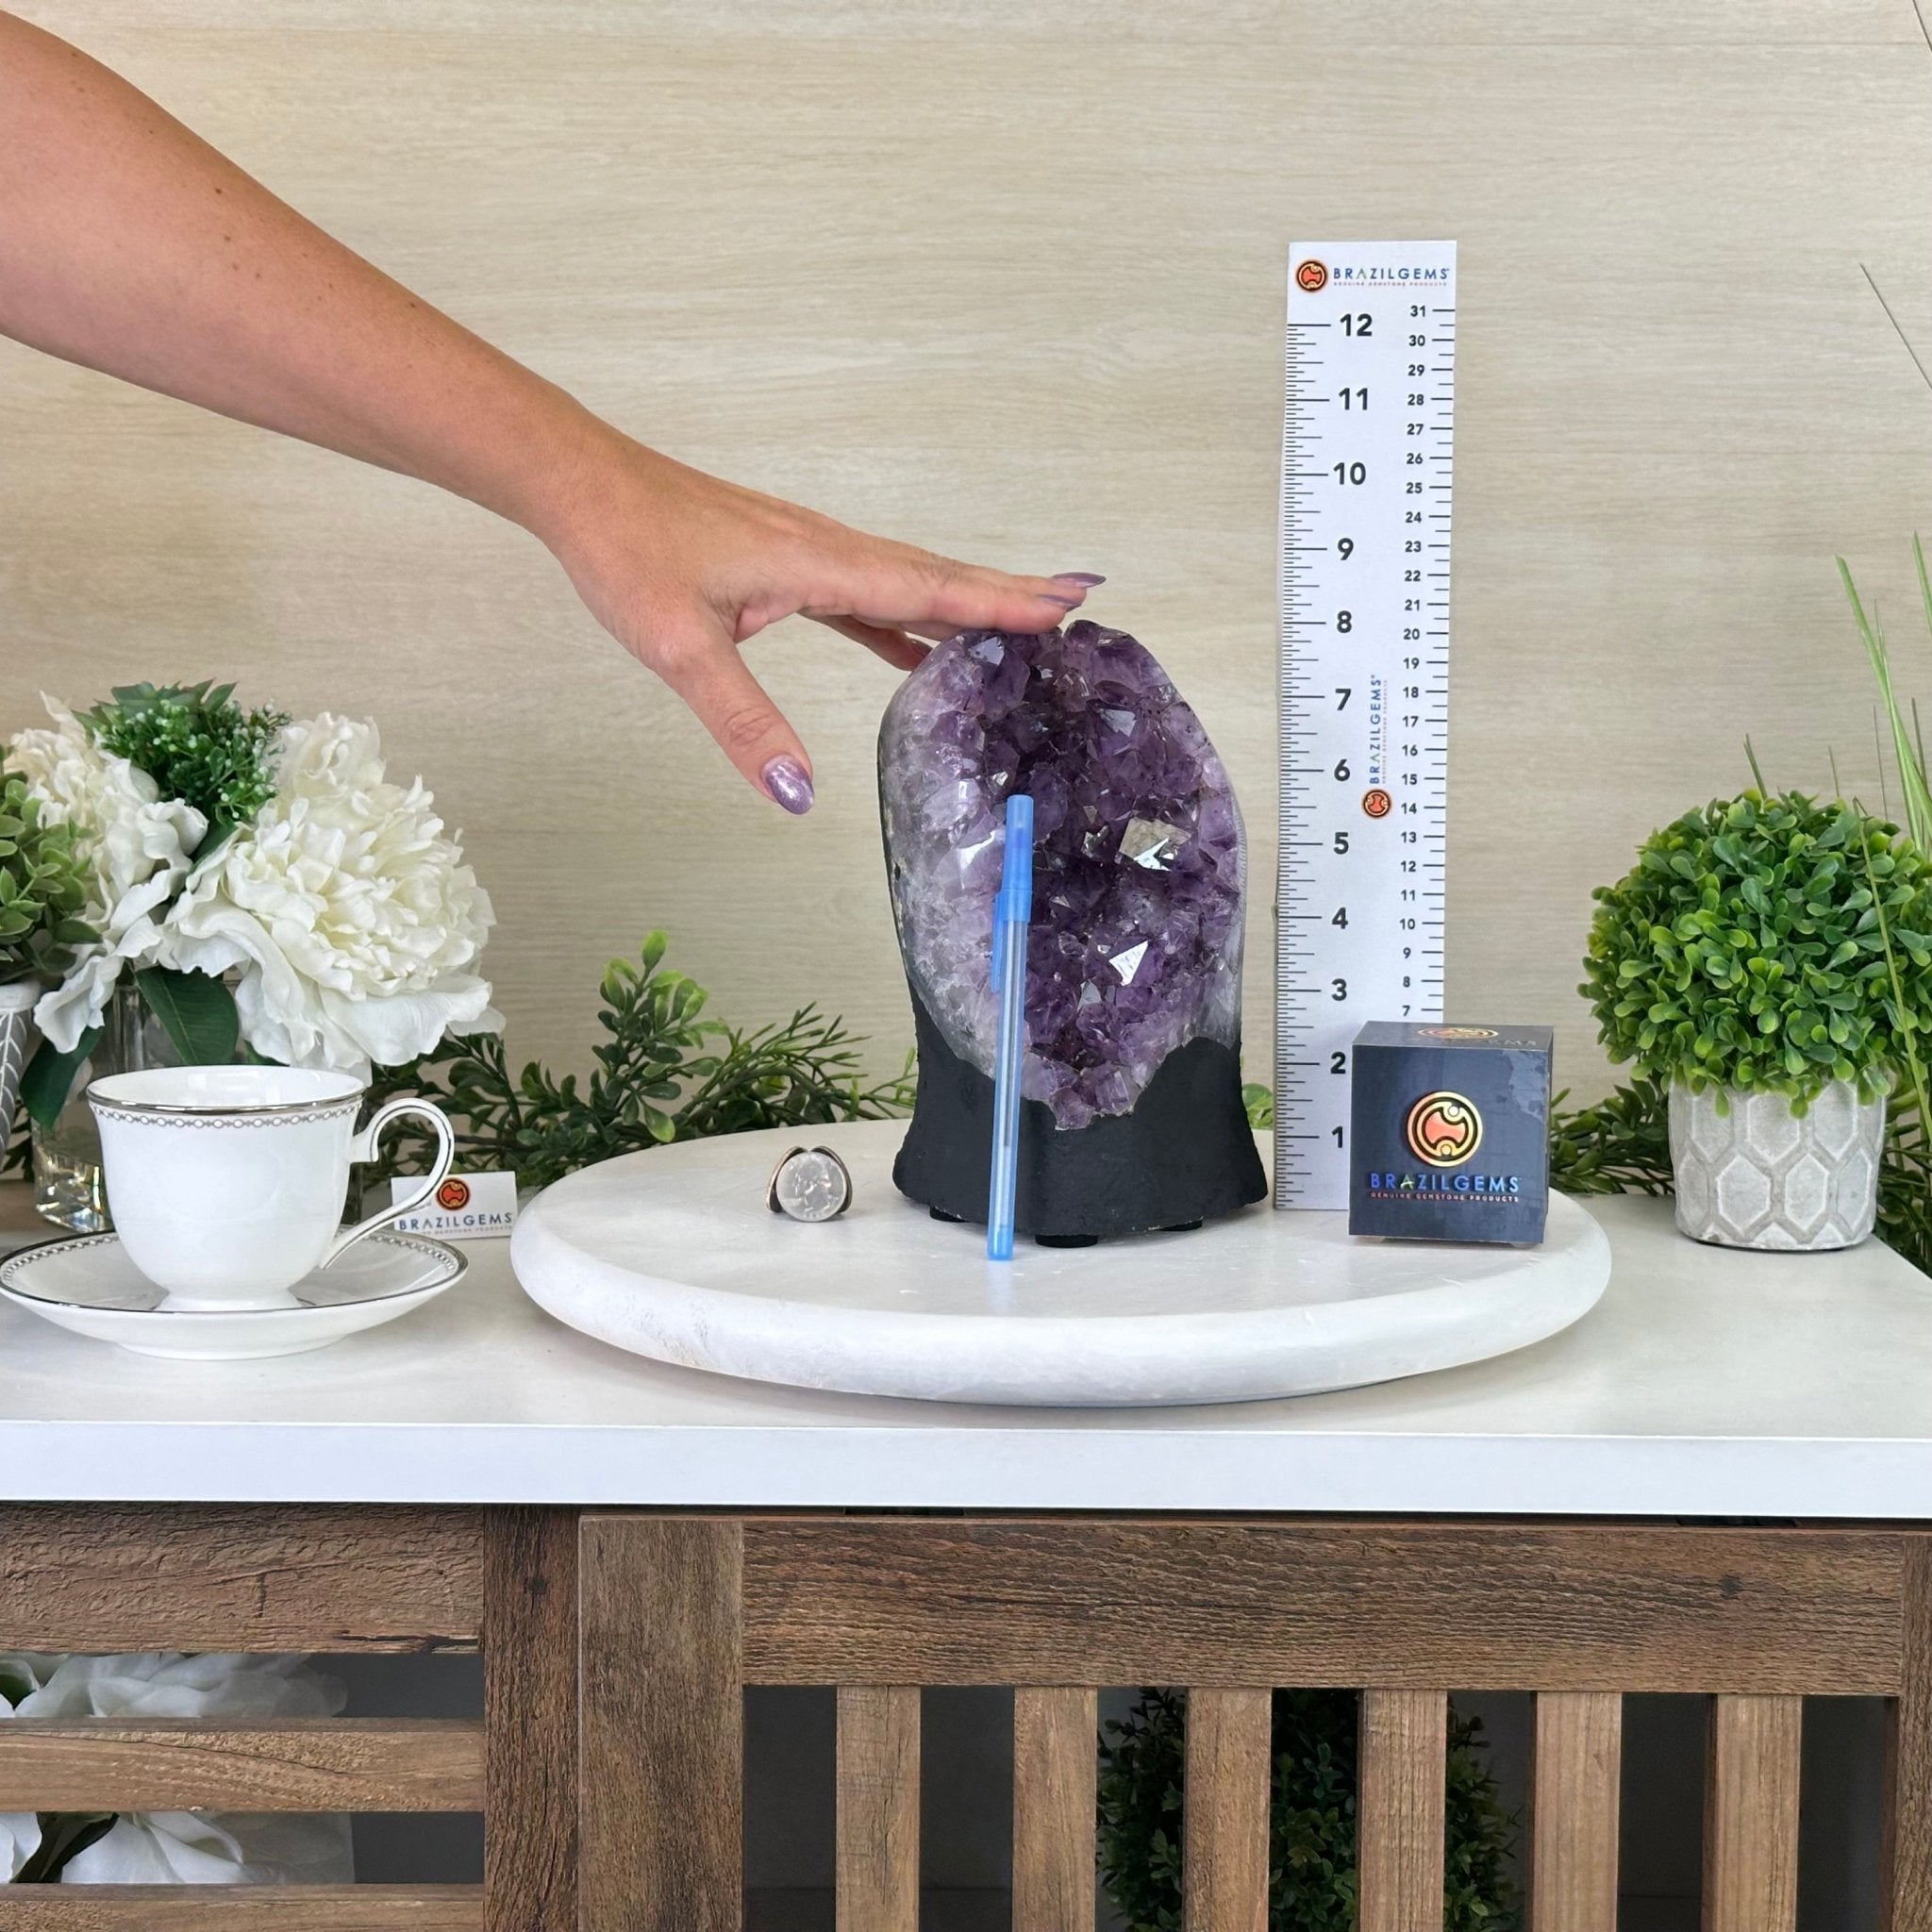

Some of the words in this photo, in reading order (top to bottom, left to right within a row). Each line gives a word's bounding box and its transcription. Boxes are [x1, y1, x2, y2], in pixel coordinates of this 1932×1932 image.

[1333, 267, 1448, 280] BRAZILGEMS
[1409, 305, 1426, 318] 31
[1339, 312, 1373, 338] 12
[1408, 334, 1426, 347] 30
[1407, 363, 1425, 377] 29
[1338, 387, 1369, 411] 11
[1407, 392, 1424, 407] 28
[1407, 423, 1424, 436] 27
[1406, 452, 1424, 465] 26
[1333, 461, 1367, 486] 10
[1406, 481, 1423, 494] 25
[1405, 510, 1423, 524] 24
[1337, 537, 1355, 561] 9
[1405, 540, 1422, 553] 23
[1404, 569, 1422, 583] 22
[1404, 598, 1421, 611] 21
[1336, 609, 1353, 634] 8
[1403, 627, 1421, 641] 20
[1403, 657, 1420, 670] 19
[1335, 688, 1352, 711] 7
[1402, 686, 1420, 699] 18
[1402, 715, 1420, 728] 17
[1369, 678, 1382, 785] BRAZILGEMS
[1401, 743, 1419, 758] 16
[1333, 758, 1351, 782] 6
[1401, 773, 1418, 786] 15
[1400, 802, 1418, 815] 14
[1333, 831, 1350, 856] 5
[1400, 831, 1417, 844] 13
[1400, 859, 1417, 873] 12
[1400, 889, 1416, 902] 11
[1331, 907, 1349, 930] 4
[1399, 917, 1416, 931] 10
[1402, 946, 1412, 959] 9
[1402, 975, 1411, 989] 8
[1331, 977, 1348, 1002] 3
[1401, 1004, 1411, 1018] 7
[1329, 1051, 1347, 1075] 2
[1331, 1125, 1343, 1149] 1
[1370, 1173, 1519, 1193] BRAZILGEMS
[399, 1212, 513, 1230] BRAZILGEMS
